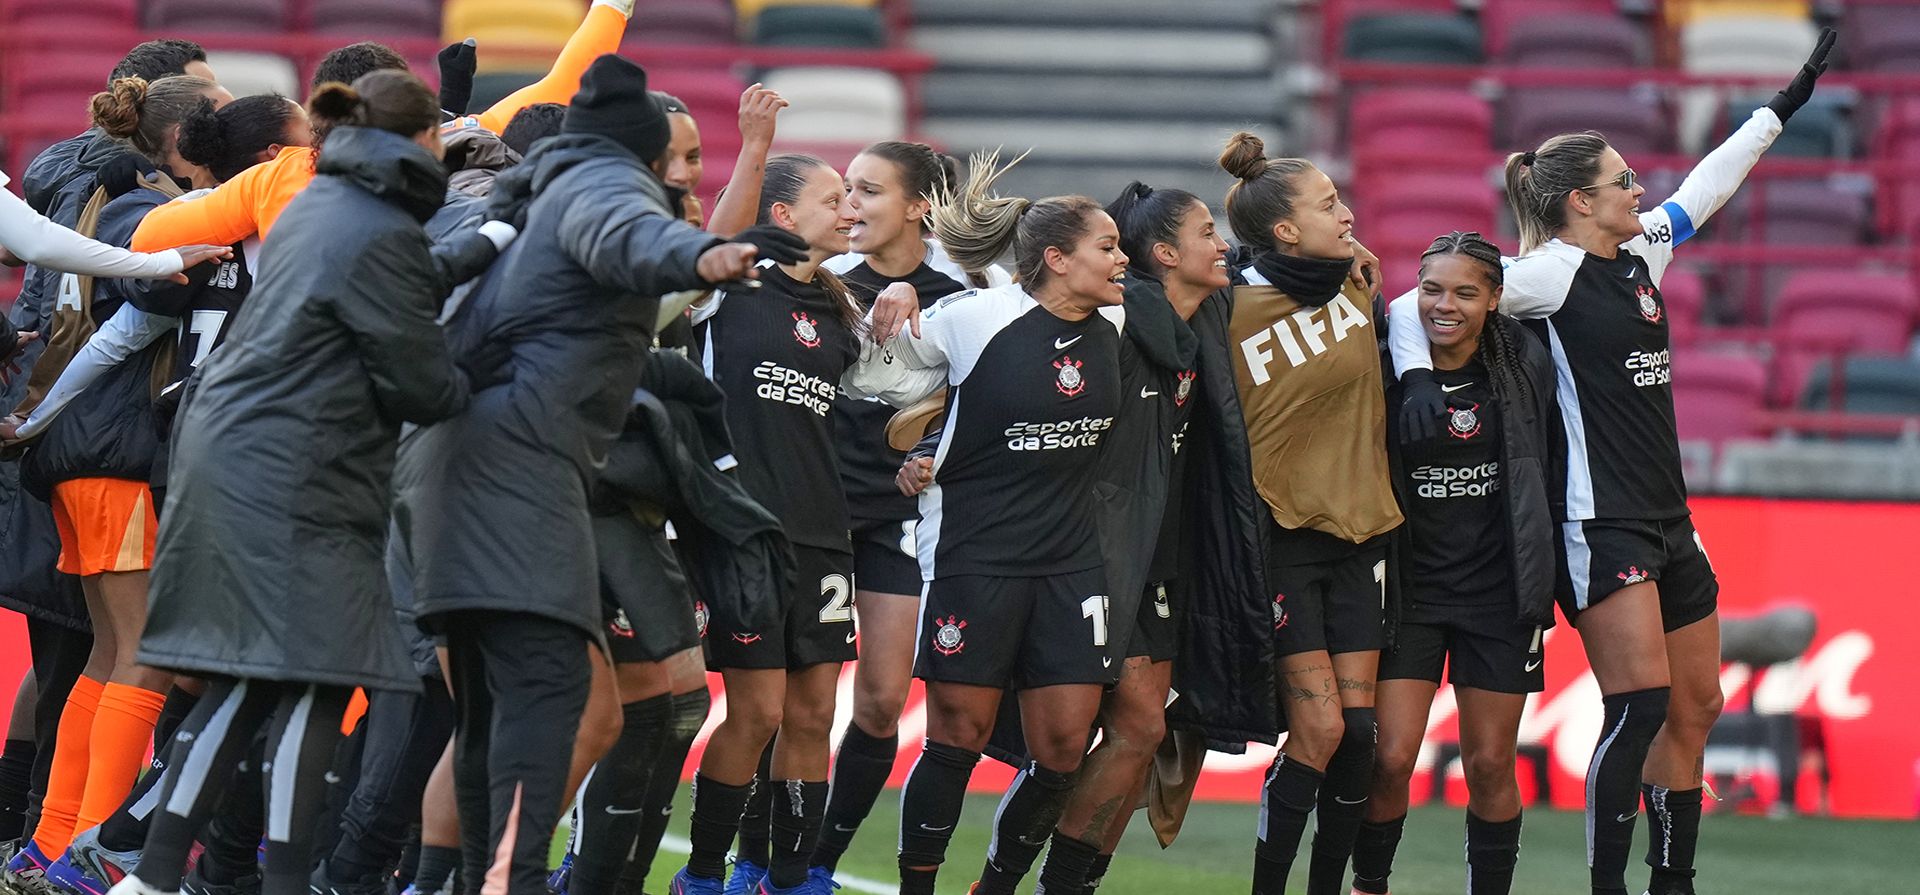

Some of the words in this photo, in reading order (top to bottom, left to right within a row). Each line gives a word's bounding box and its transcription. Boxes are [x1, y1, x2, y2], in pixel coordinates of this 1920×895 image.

[1240, 292, 1370, 387] FIFA
[753, 361, 836, 401] Esportes
[756, 382, 785, 402] da
[1004, 416, 1114, 438] Esportes
[1008, 435, 1040, 451] da
[1042, 432, 1100, 450] Sorte
[1418, 481, 1447, 498] da
